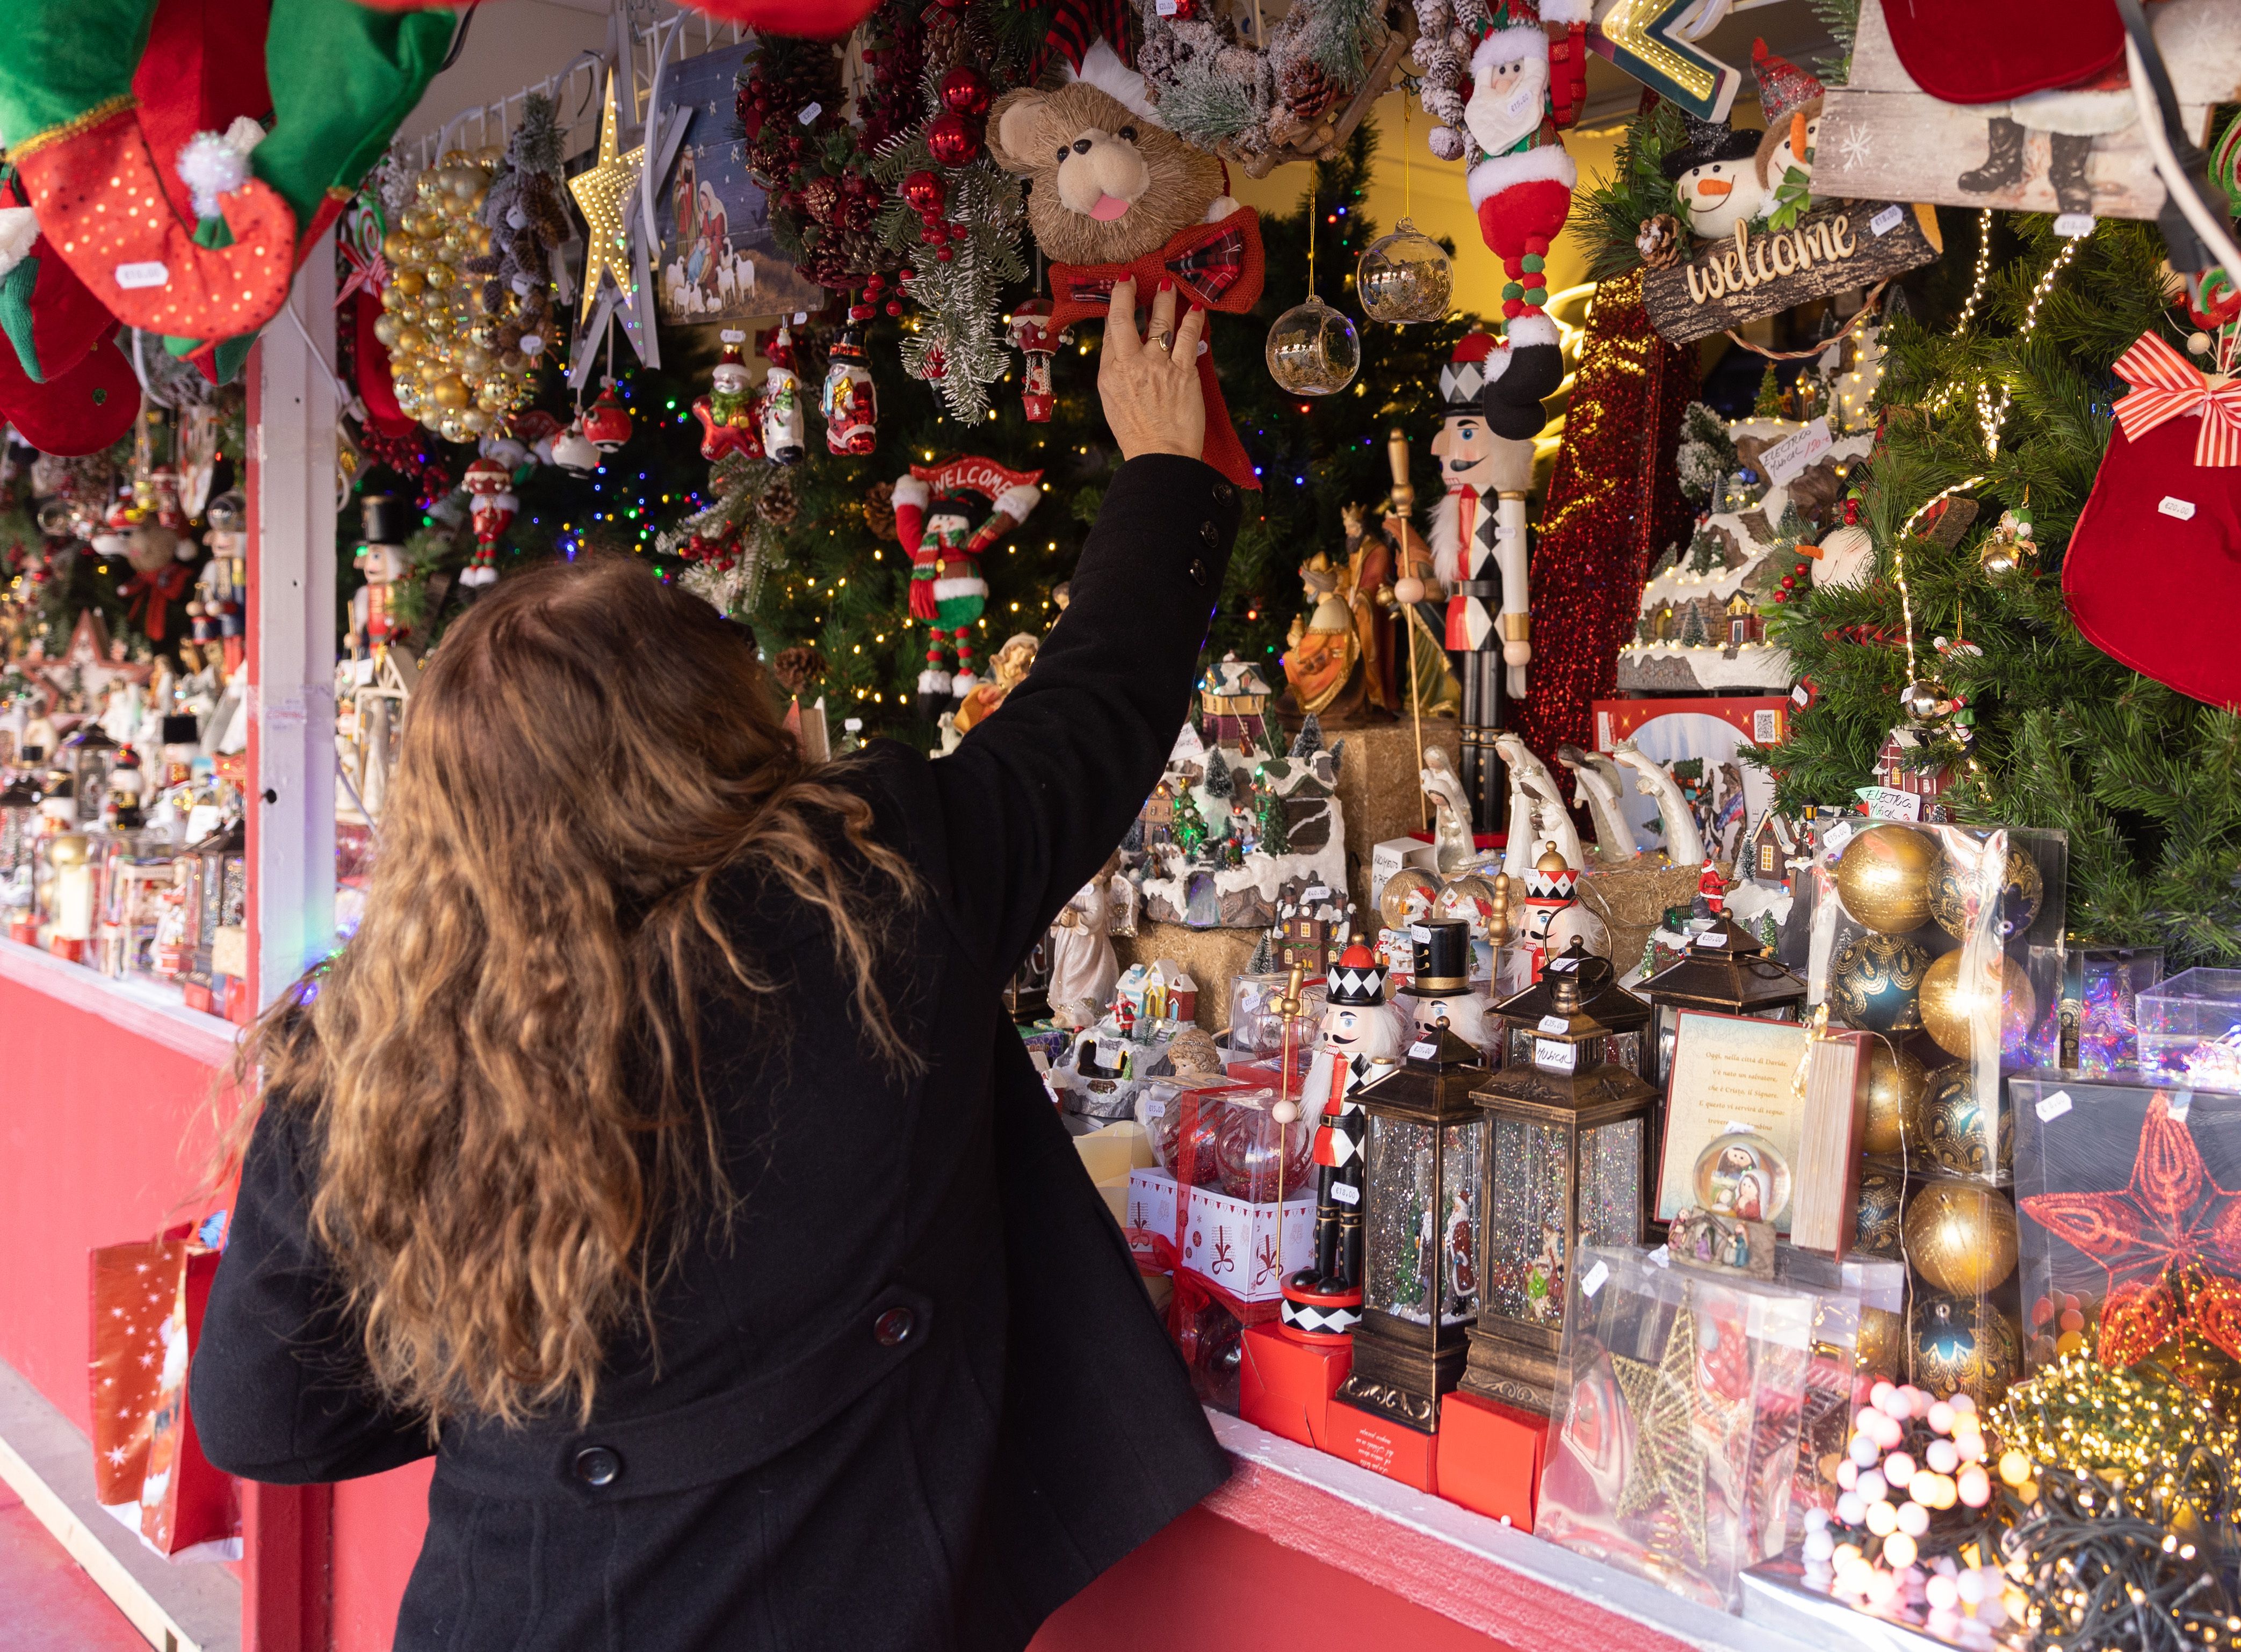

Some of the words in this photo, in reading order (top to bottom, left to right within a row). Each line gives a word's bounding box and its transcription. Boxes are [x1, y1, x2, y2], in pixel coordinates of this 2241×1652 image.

[1510, 93, 1529, 112] €15.00
[1874, 209, 1898, 226] €18.00
[1686, 215, 1856, 305] welcome
[930, 466, 1014, 501] WELCOME
[2164, 502, 2189, 515] €20.00
[1827, 828, 1847, 844] €15.00
[1412, 929, 1428, 939] €18.00
[1245, 995, 1260, 1006] €15.00
[1544, 1019, 1565, 1030] €35.00
[1414, 1046, 1433, 1055] €35.00
[1705, 1052, 1722, 1060] Oggi,
[1149, 1105, 1163, 1113] €15.00
[1705, 1101, 1726, 1110] questo
[1766, 1109, 1785, 1117] segno:
[1336, 1186, 1356, 1199] €18.00
